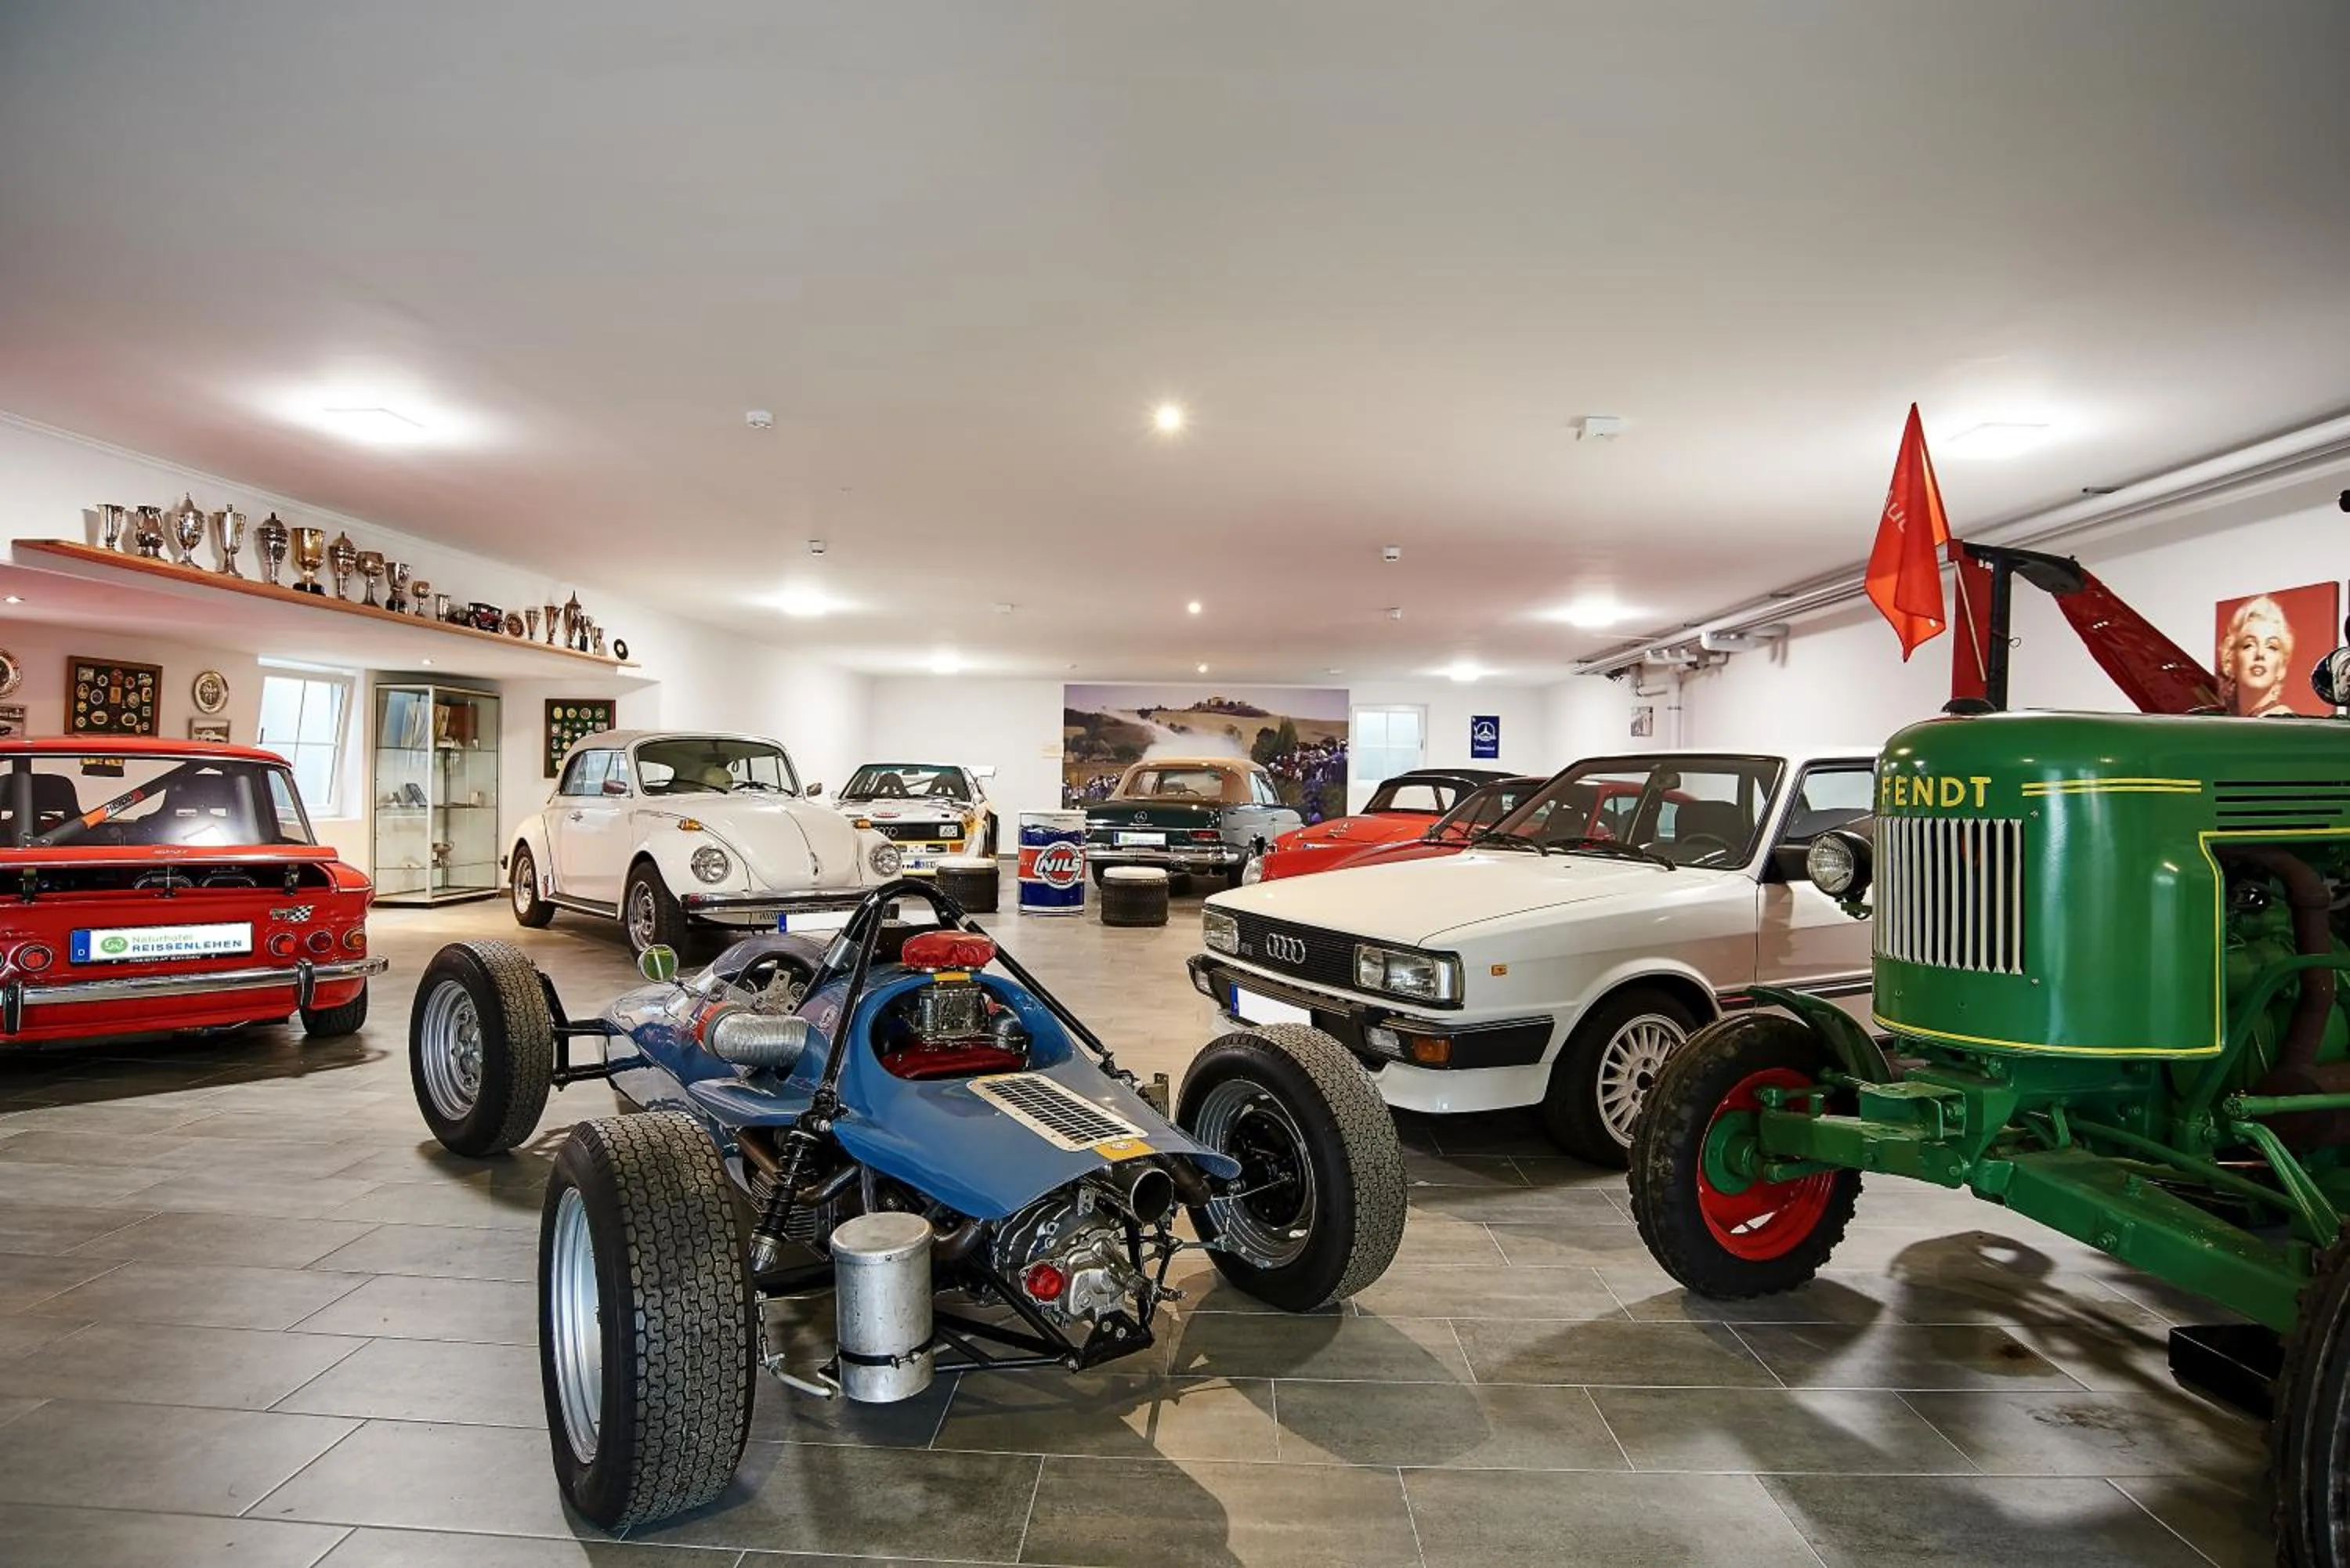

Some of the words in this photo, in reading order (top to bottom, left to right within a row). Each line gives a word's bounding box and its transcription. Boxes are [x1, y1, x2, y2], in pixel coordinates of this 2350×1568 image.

[1882, 775, 1991, 807] FENDT
[132, 934, 193, 943] Naturhotel
[132, 939, 242, 952] REISSENLEHEN
